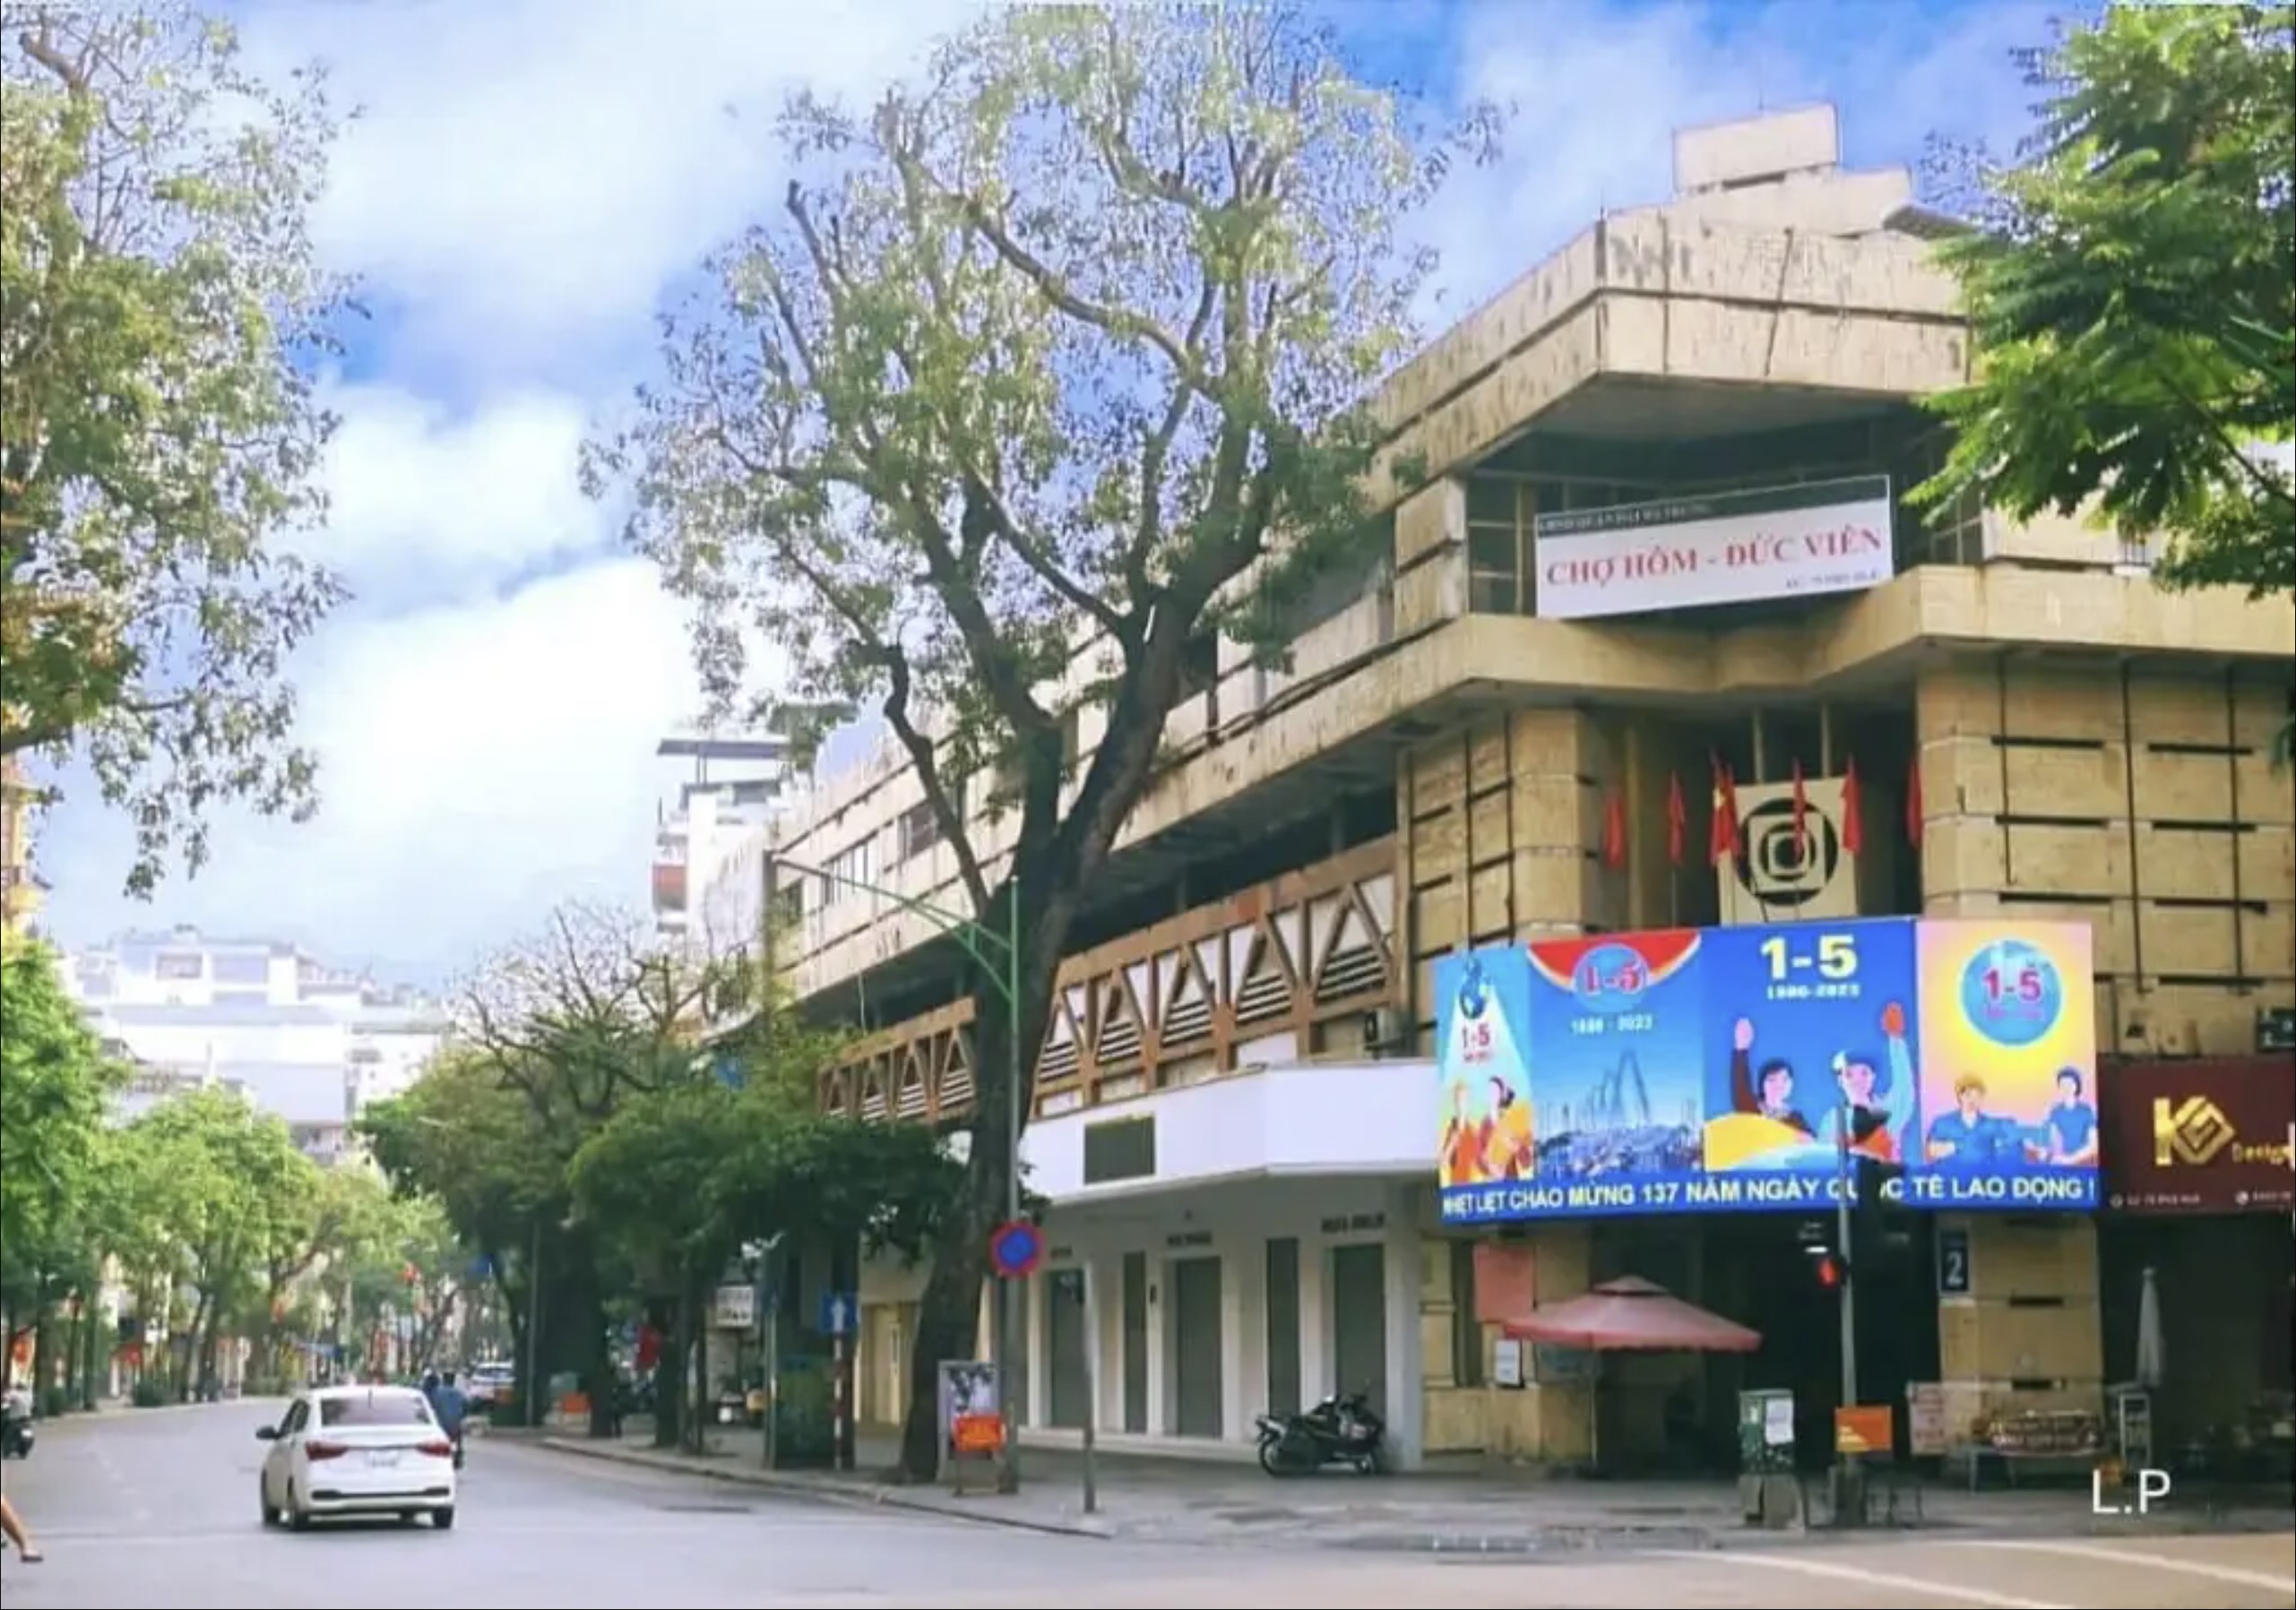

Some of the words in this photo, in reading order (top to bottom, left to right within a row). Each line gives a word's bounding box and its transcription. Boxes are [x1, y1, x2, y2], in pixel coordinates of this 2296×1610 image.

[1547, 556, 1616, 589] CHỢ
[1625, 545, 1697, 578] HÔM
[1804, 523, 1882, 556] VIÊN
[1761, 935, 1858, 979] 1-5
[1584, 964, 1642, 994] 1-5
[1981, 969, 2041, 1002] 1-5
[1509, 1184, 1564, 1210] CHÀO
[1568, 1180, 1635, 1206] MỪNG
[1642, 1183, 1679, 1203] 137
[1686, 1176, 1741, 1203] NĂM
[1747, 1175, 1819, 1201] NGÀY
[1951, 1176, 2007, 1200] LAO
[1947, 1251, 1964, 1286] 2
